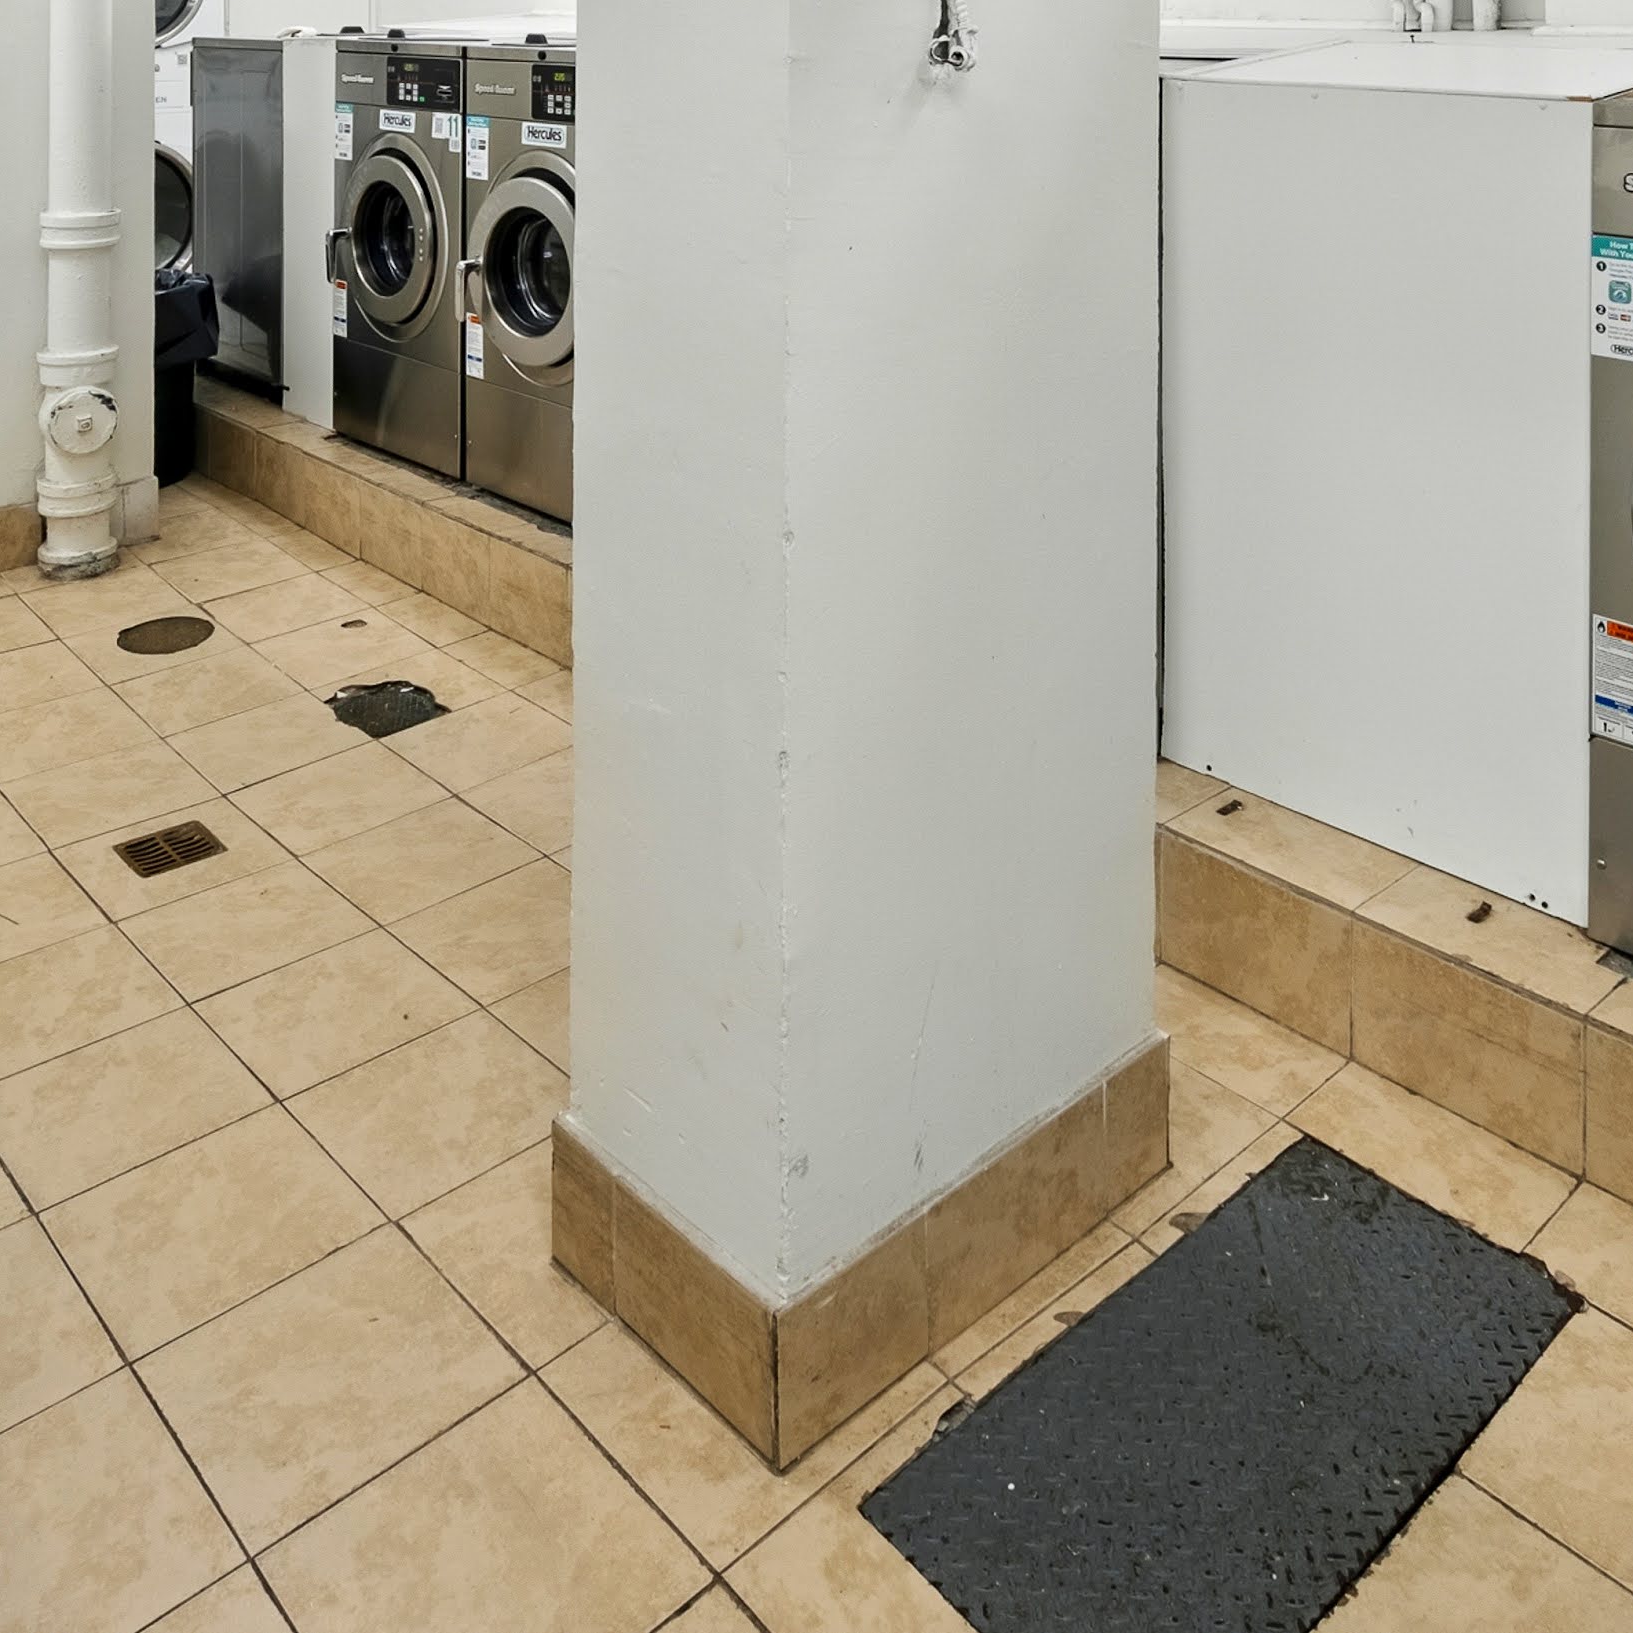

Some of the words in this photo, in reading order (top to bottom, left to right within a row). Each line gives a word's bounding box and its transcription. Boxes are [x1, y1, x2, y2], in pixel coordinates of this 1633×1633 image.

[384, 112, 412, 127] Hercules
[447, 115, 459, 138] 11
[527, 125, 562, 142] Hercules
[1599, 248, 1619, 257] With
[1610, 241, 1629, 250] How
